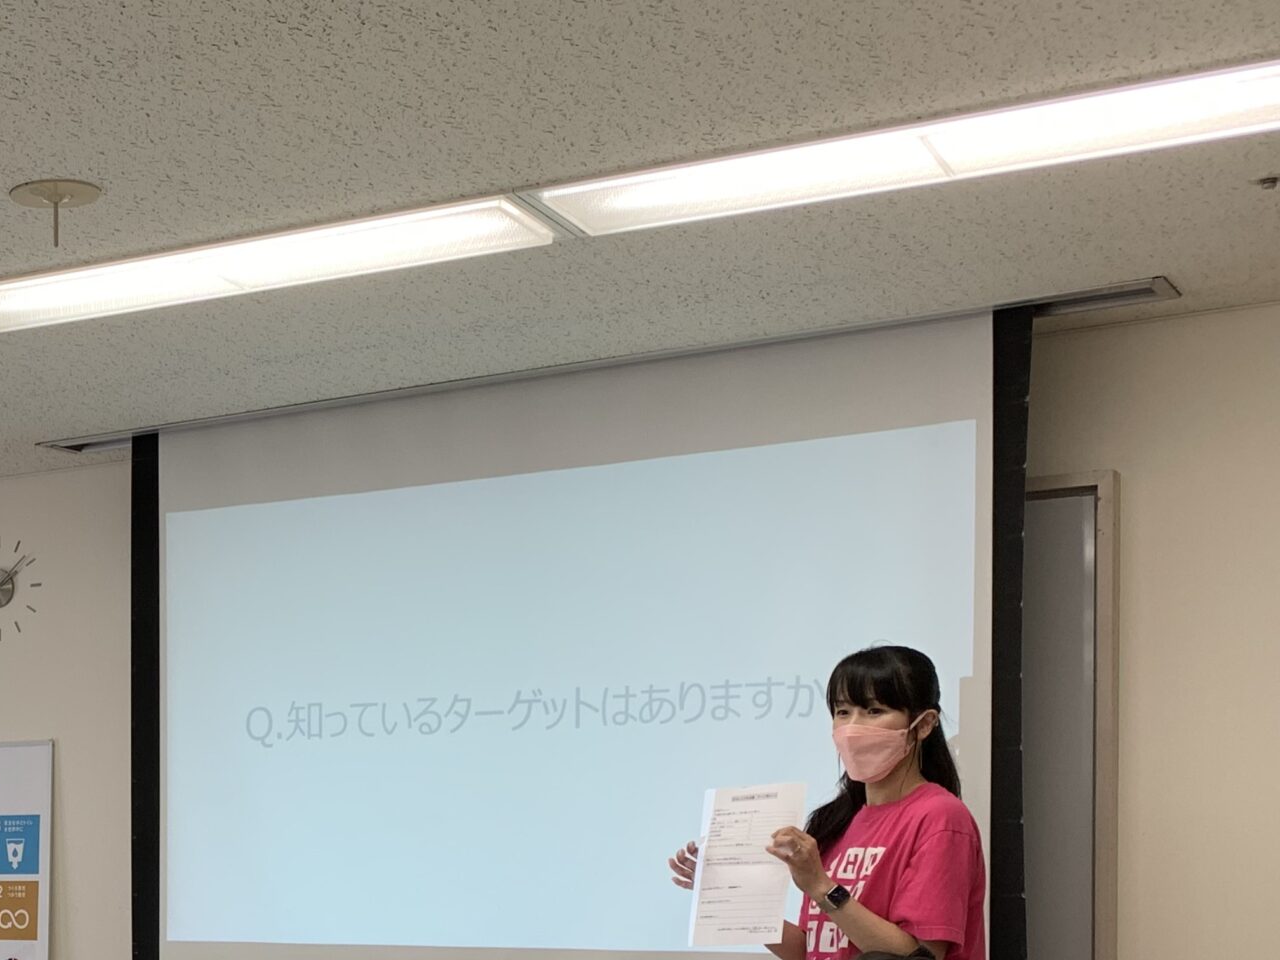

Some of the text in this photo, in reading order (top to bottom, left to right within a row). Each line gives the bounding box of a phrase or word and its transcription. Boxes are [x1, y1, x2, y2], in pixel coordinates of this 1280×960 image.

[245, 675, 826, 748] Q.知っているターゲットはありますか
